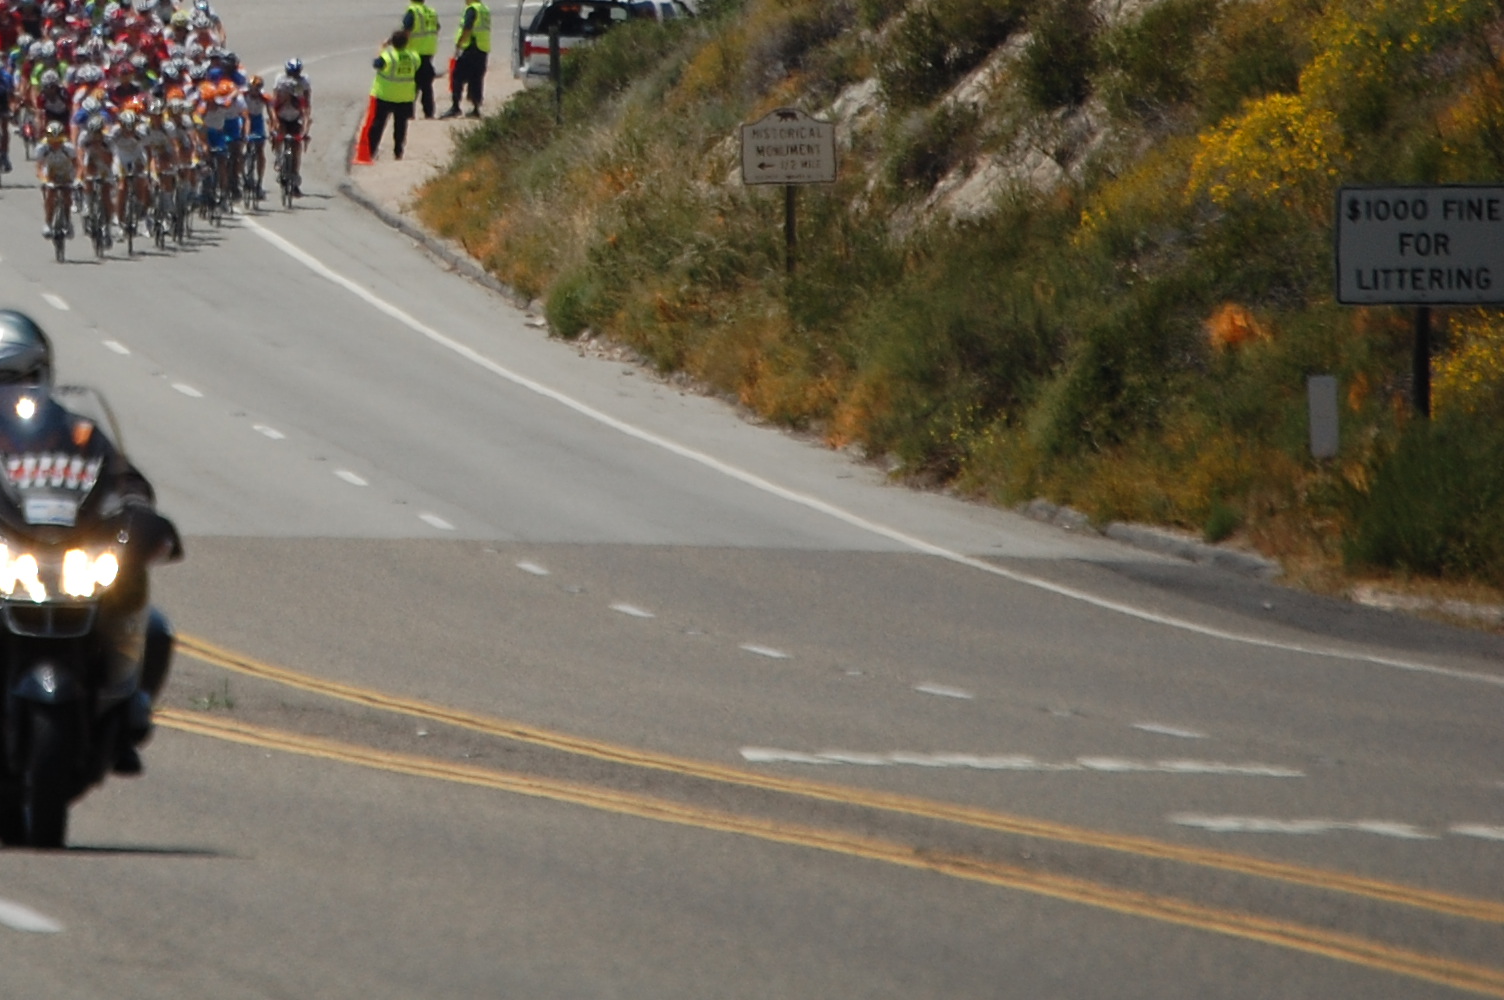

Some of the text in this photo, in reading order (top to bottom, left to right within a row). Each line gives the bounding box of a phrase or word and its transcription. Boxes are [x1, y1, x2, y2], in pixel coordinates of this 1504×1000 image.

[752, 127, 822, 139] HISTORICAL
[756, 144, 821, 157] MONUMENT
[780, 160, 820, 170] 1/2 MILE
[1347, 198, 1502, 222] $1000 FINE
[1399, 232, 1451, 256] FOR
[1356, 268, 1492, 291] LITTERING
